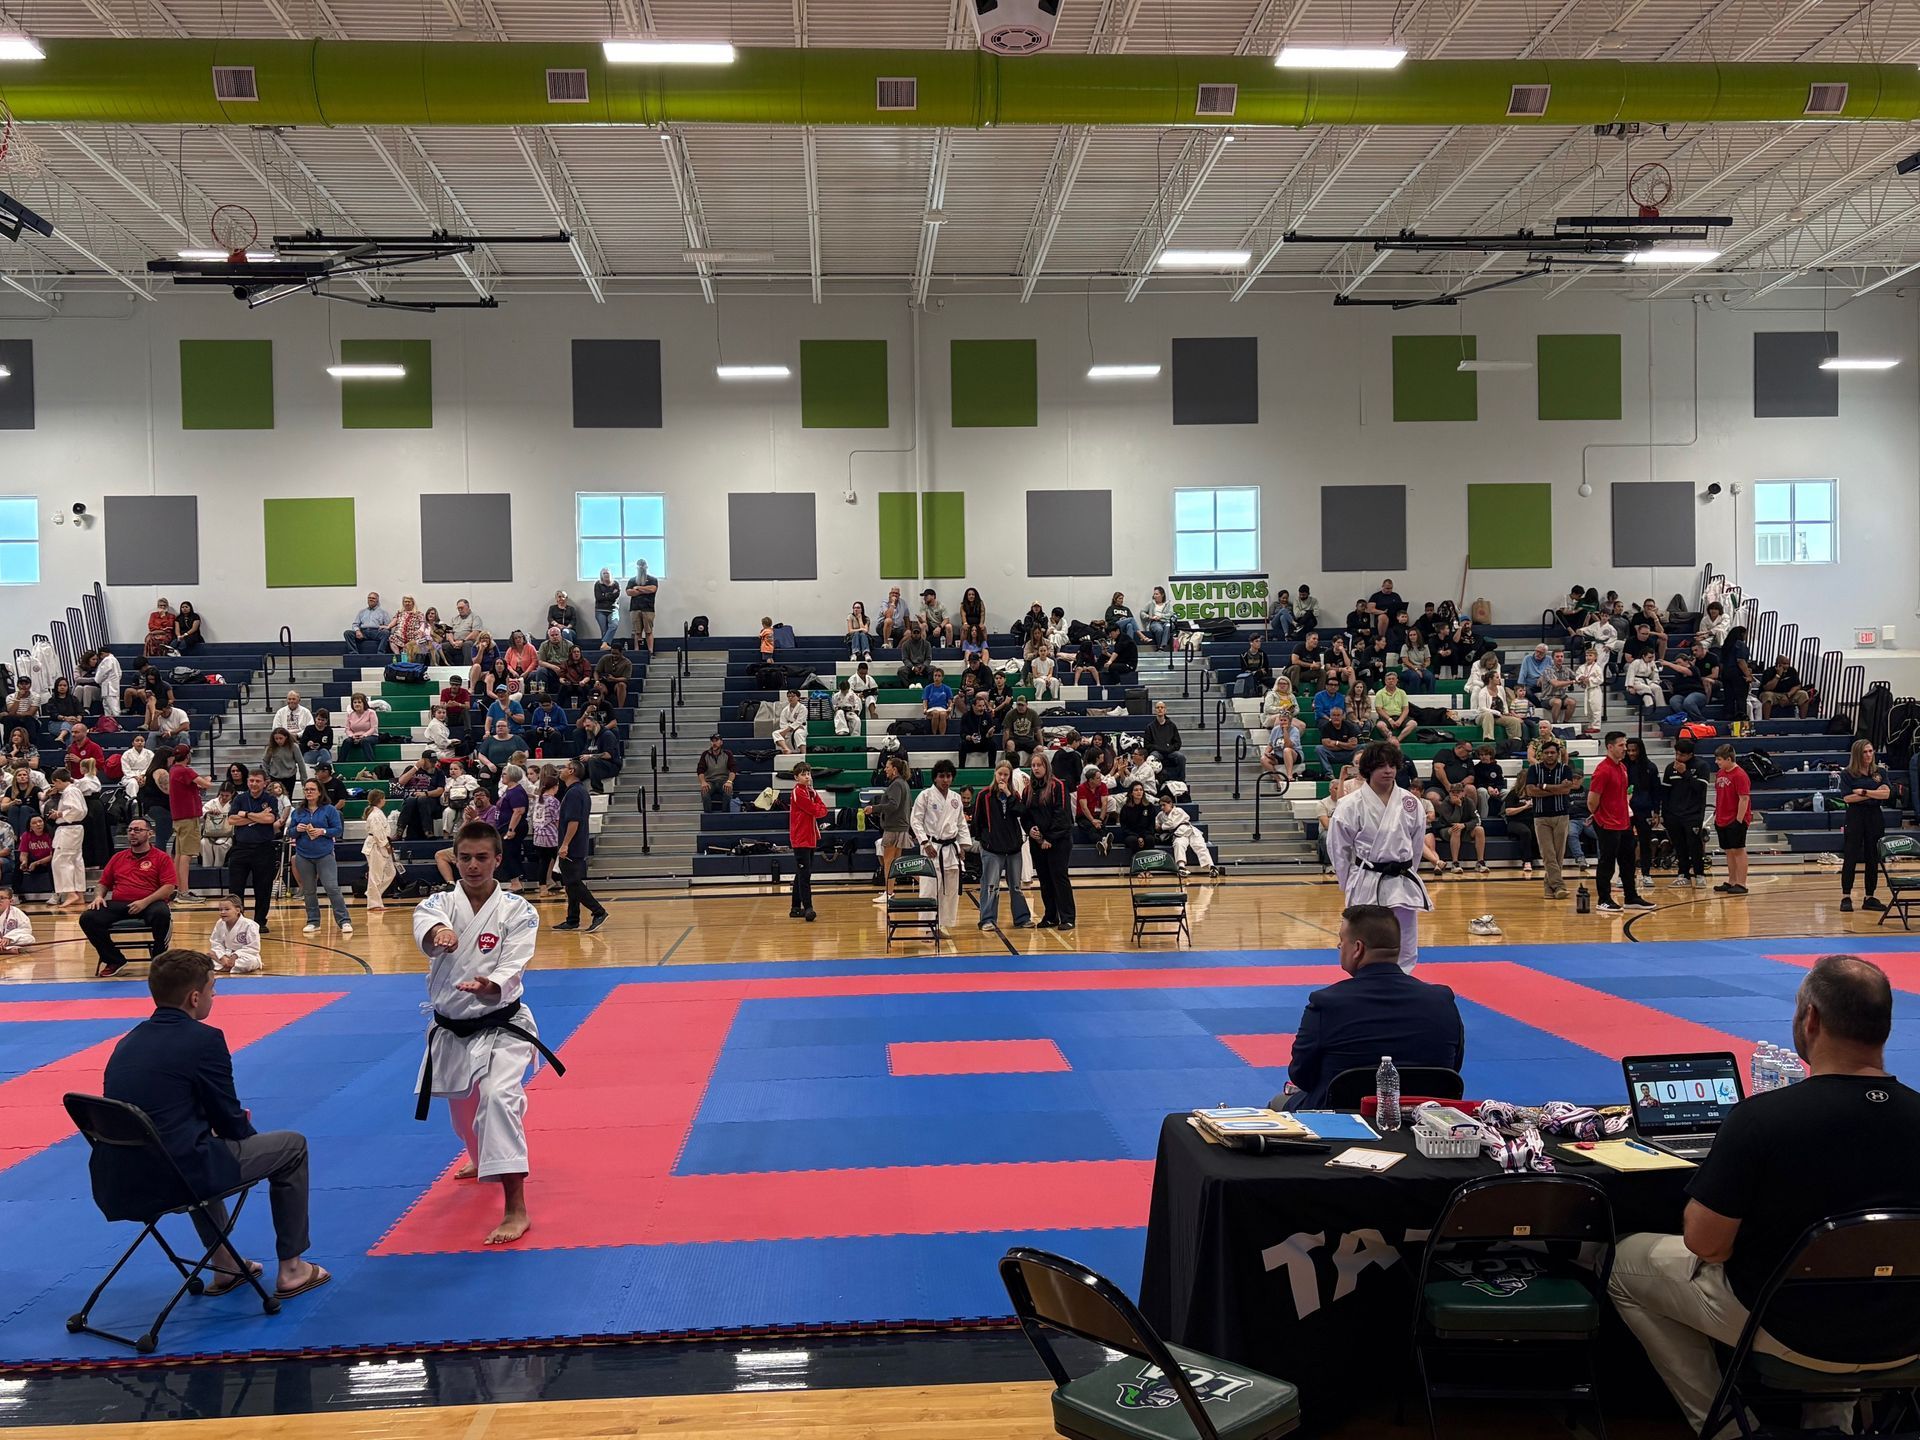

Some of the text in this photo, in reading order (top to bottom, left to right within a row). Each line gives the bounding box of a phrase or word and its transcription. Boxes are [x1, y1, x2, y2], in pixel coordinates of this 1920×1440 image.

[1170, 580, 1269, 601] VISITORS
[1173, 602, 1268, 619] SECTION
[1861, 632, 1873, 642] EXIT
[1887, 839, 1911, 849] LEGION
[898, 859, 924, 869] LEGION
[1139, 854, 1164, 864] LEGION
[480, 936, 495, 944] USA
[1666, 1082, 1705, 1100] 0 0
